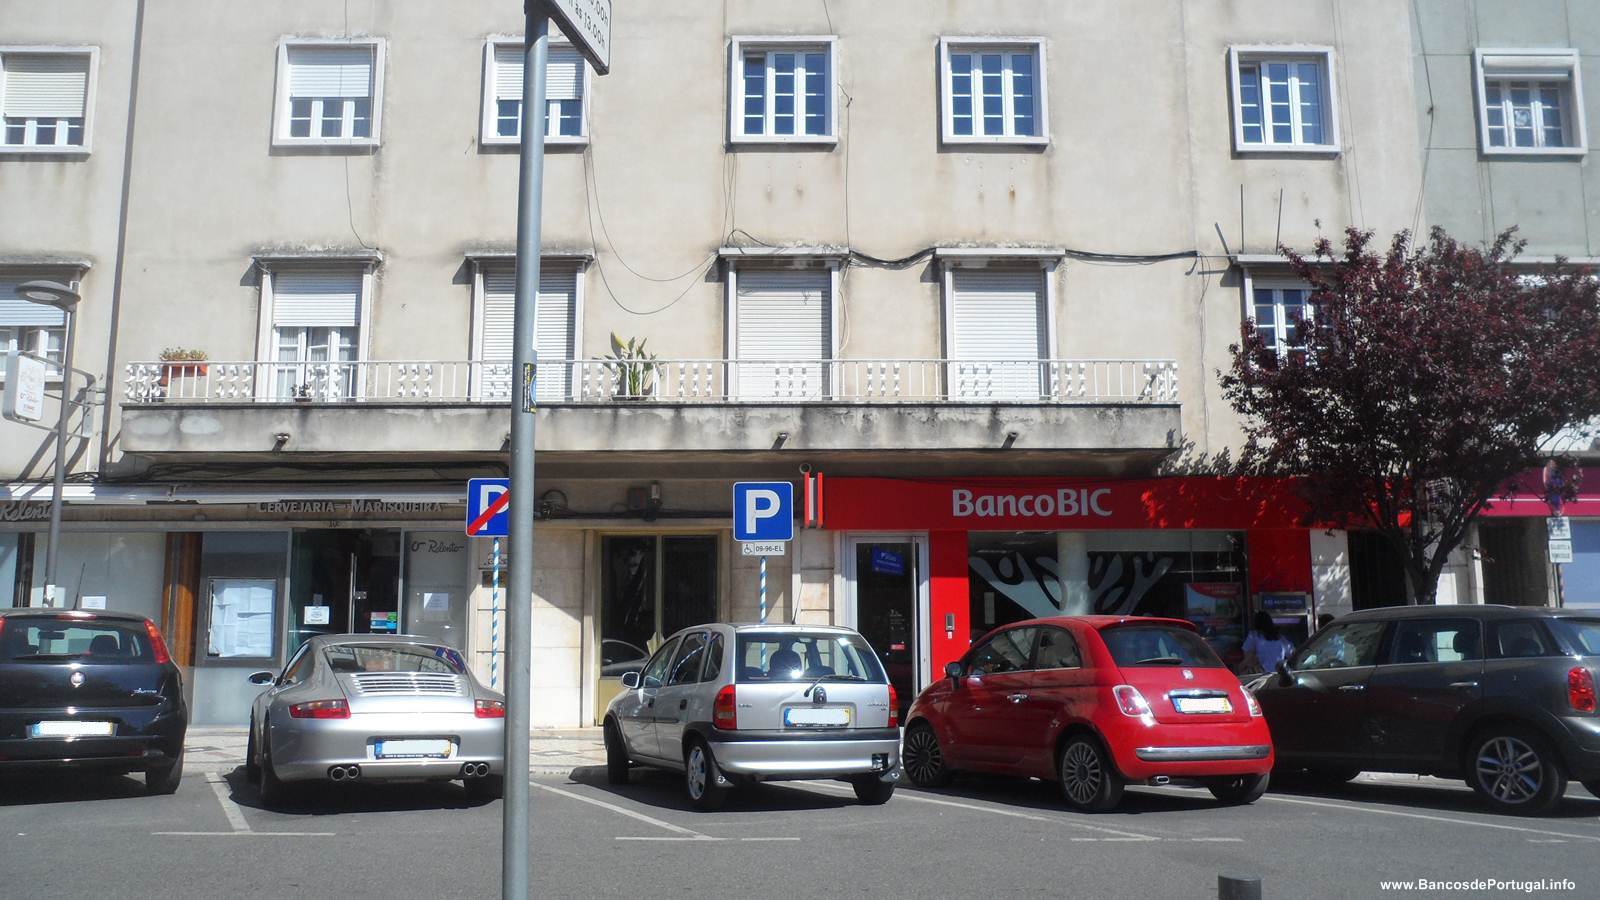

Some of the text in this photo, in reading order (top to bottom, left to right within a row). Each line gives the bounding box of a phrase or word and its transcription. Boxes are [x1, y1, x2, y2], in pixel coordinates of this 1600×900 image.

[257, 499, 442, 513] CERVEJARIA MARISQUEIRA
[480, 485, 509, 530] P
[746, 489, 780, 533] P
[952, 488, 1113, 516] BancoBIC
